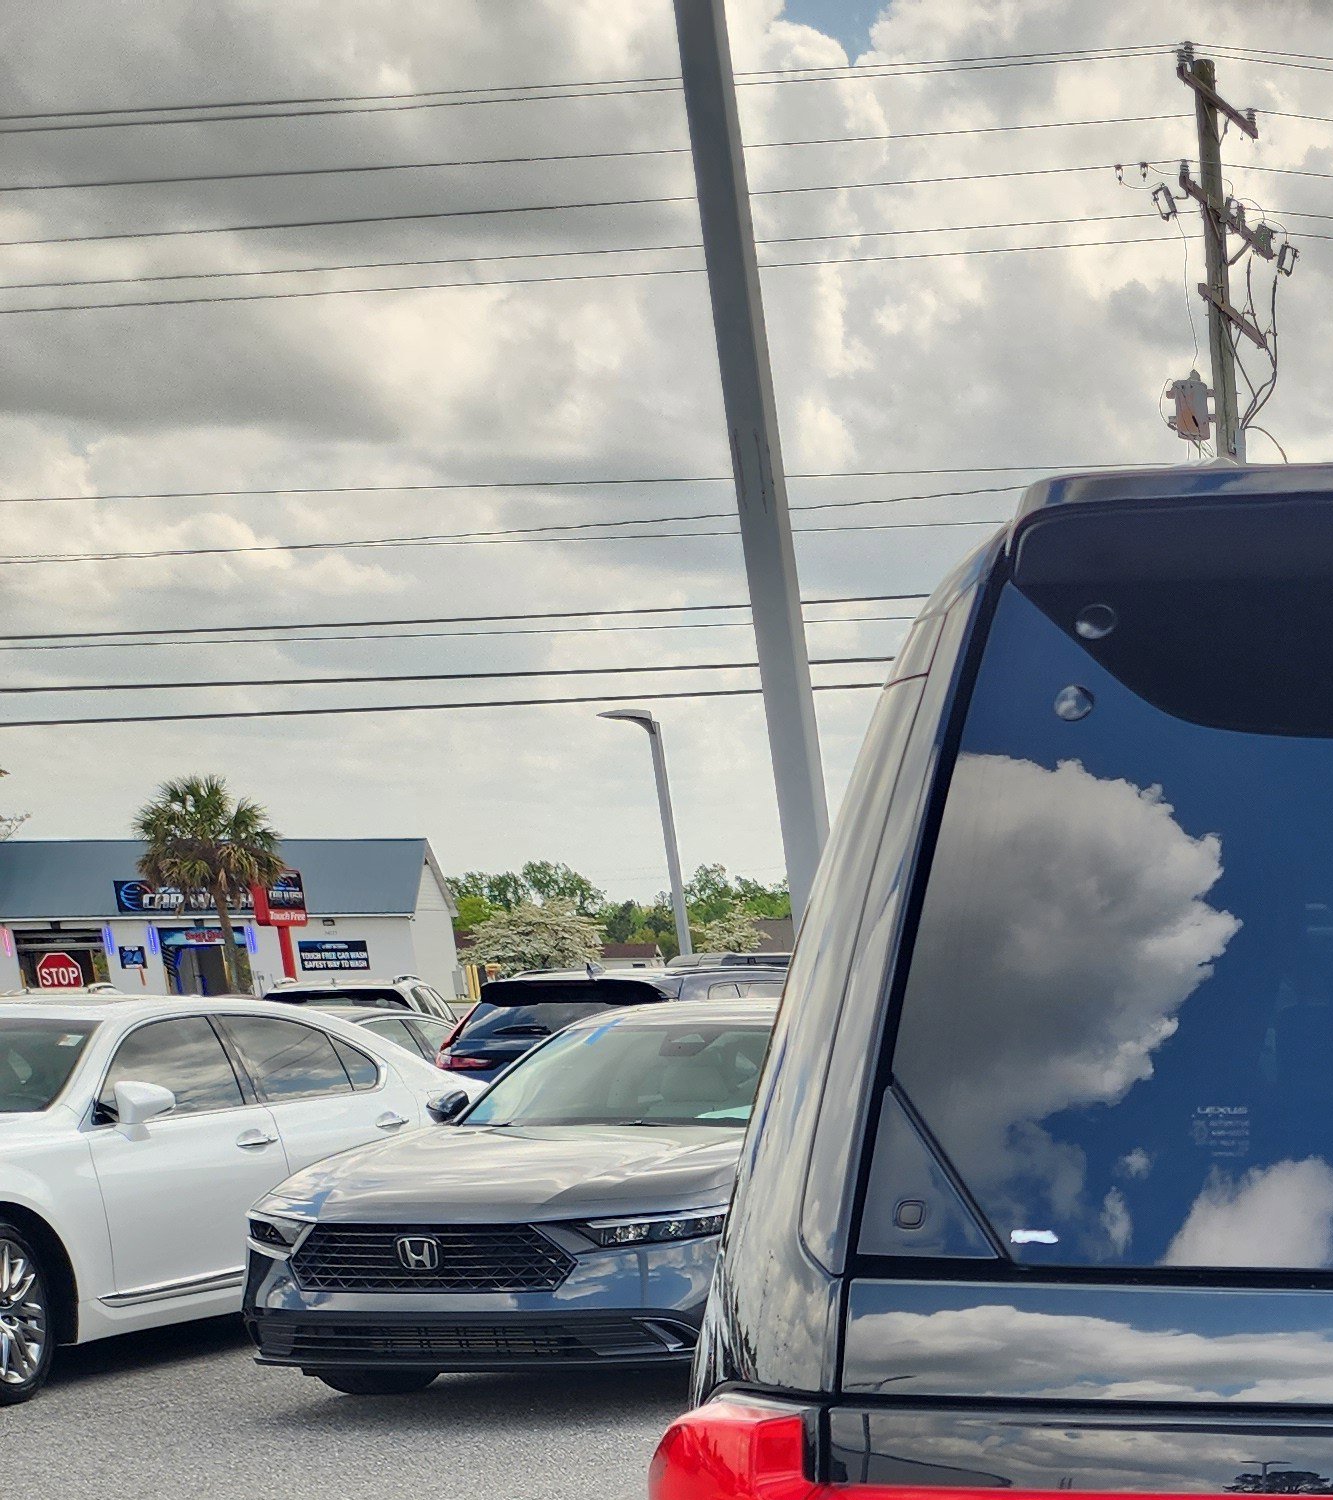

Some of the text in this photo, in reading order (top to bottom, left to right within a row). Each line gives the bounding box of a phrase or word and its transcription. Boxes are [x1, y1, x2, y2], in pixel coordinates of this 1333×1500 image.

[142, 893, 184, 909] CAR
[269, 910, 306, 921] Touch Free
[301, 951, 321, 960] TOUCH
[337, 951, 350, 960] CAR
[350, 951, 368, 960] WASH
[304, 960, 327, 969] SAFEST
[341, 960, 349, 968] TO
[350, 960, 368, 968] WASH
[41, 967, 79, 986] STOP
